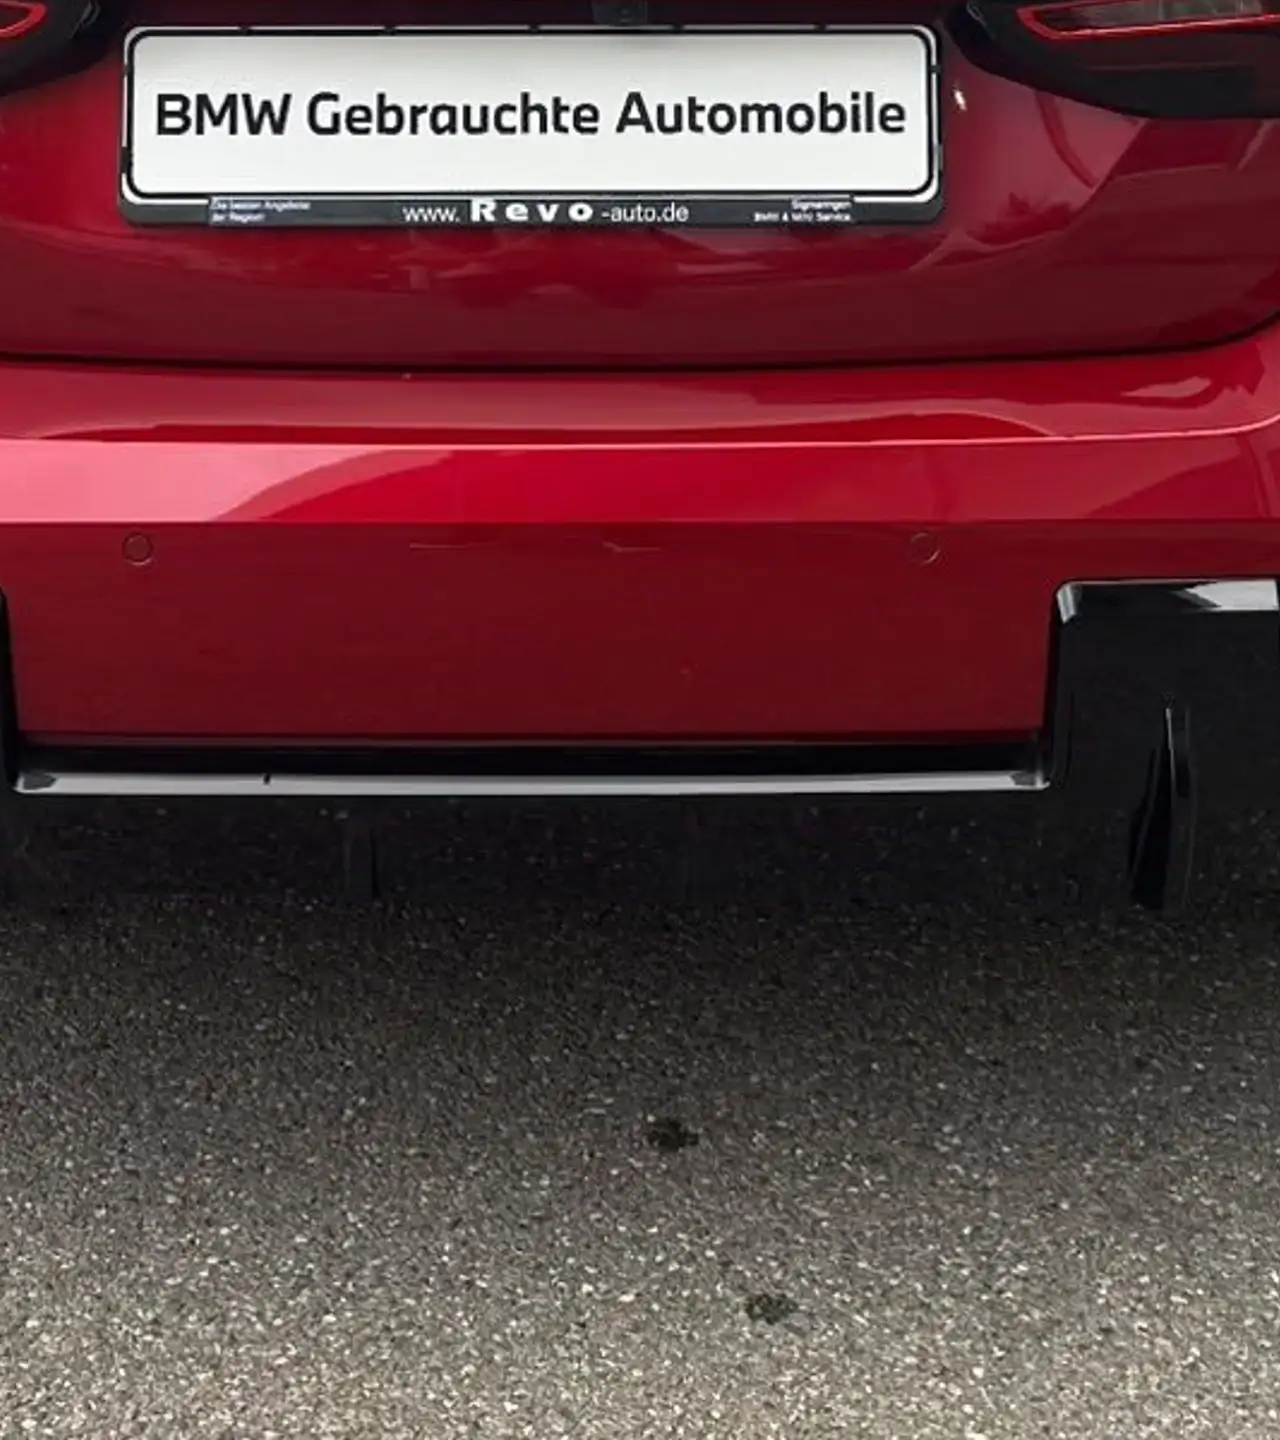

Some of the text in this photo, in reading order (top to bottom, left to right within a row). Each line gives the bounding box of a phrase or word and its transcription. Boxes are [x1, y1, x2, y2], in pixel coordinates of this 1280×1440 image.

[156, 90, 906, 136] BMW Gebrauchte Automobile
